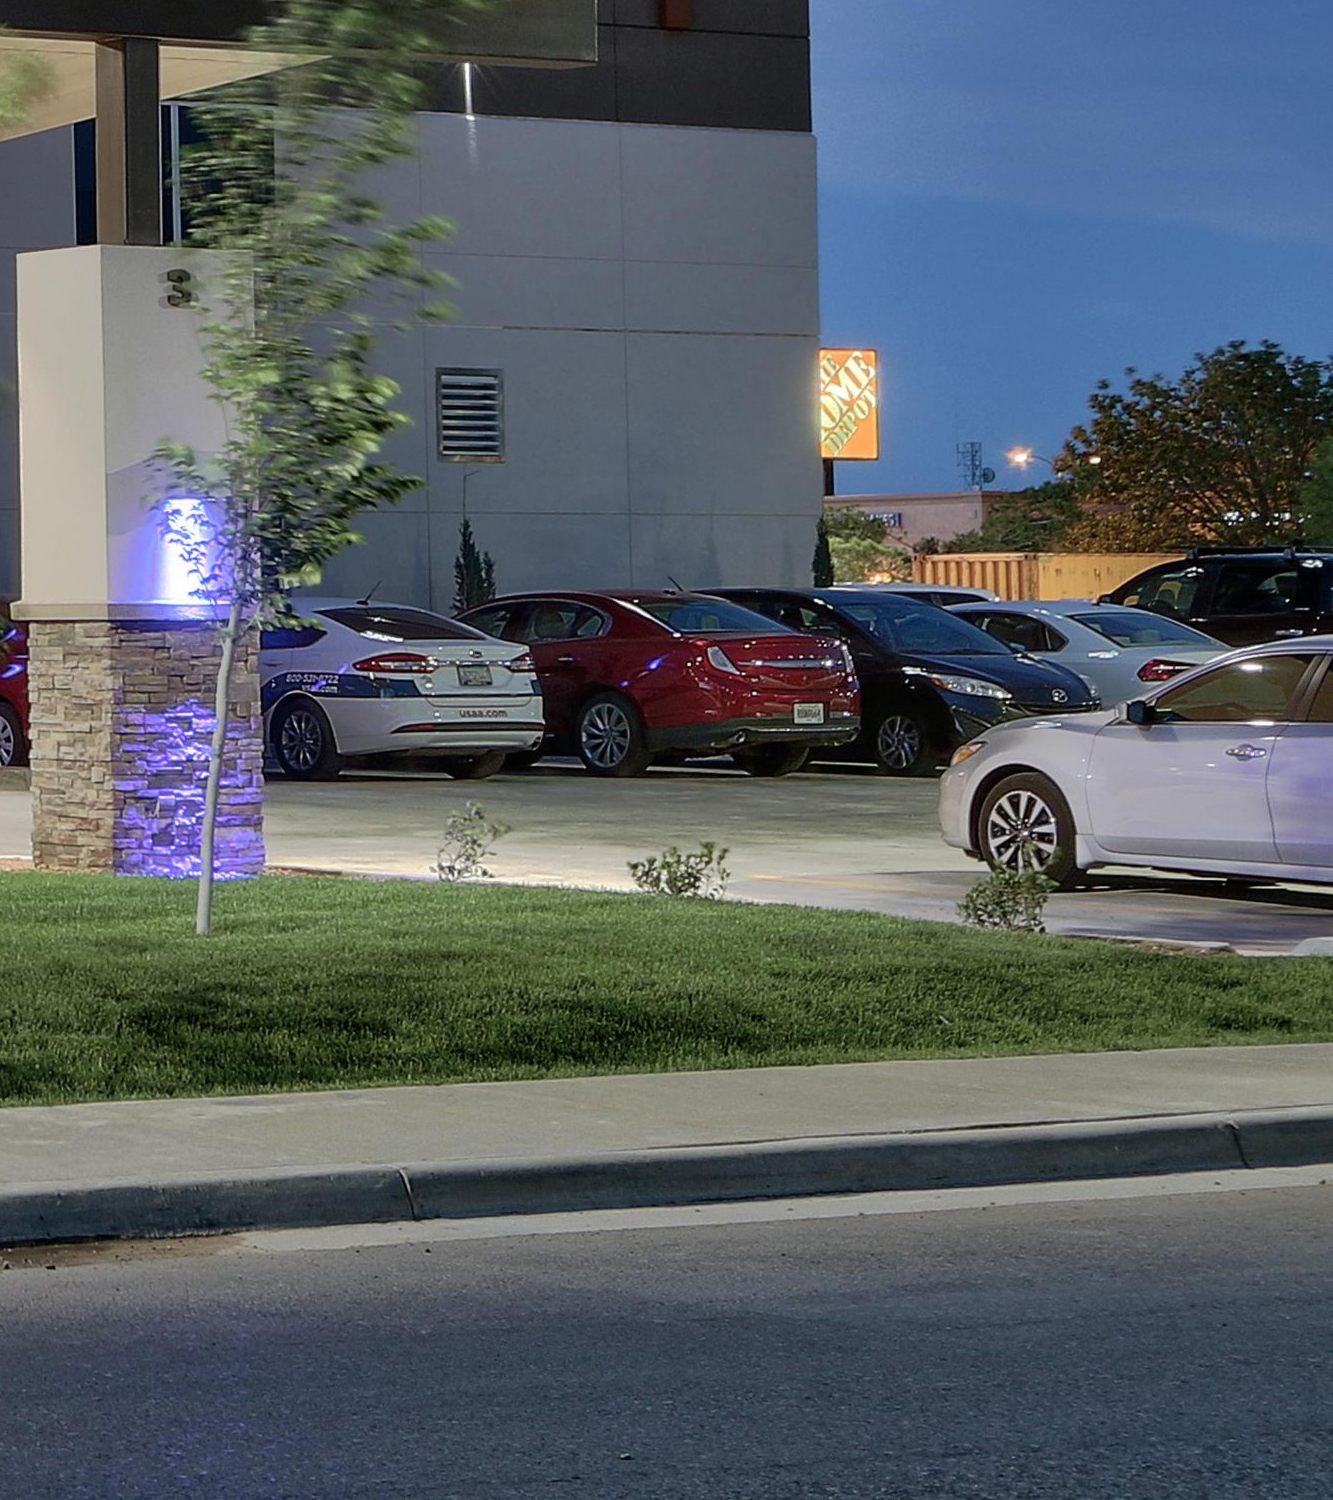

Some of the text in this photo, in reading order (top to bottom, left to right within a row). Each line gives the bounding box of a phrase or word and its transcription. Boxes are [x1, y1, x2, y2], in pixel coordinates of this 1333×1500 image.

[820, 350, 876, 442] OME
[823, 384, 877, 458] DEPOT
[459, 709, 508, 718] usaa.com
